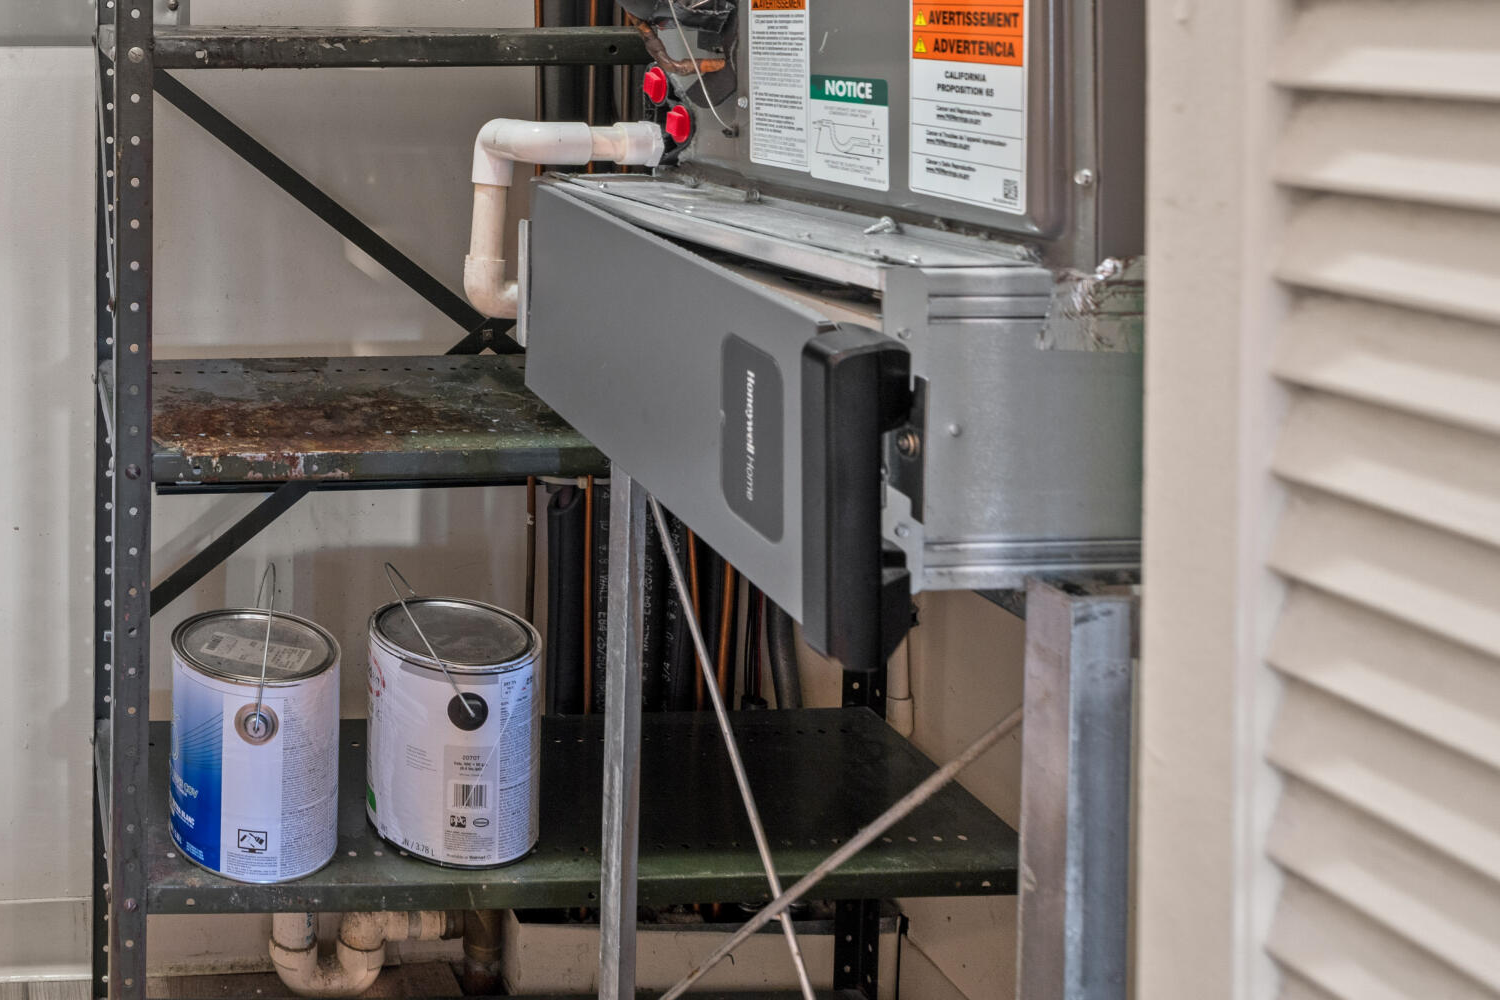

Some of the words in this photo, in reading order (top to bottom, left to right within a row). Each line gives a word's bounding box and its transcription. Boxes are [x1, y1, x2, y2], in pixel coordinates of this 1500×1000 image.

[928, 10, 1019, 28] AVERTISSEMENT
[933, 38, 1015, 58] ADVERTENCIA
[944, 70, 987, 82] CALIFORNIA
[824, 79, 873, 100] NOTICE
[936, 83, 984, 97] PROPOSITION
[745, 370, 756, 454] Honeywell
[746, 454, 755, 501] Home
